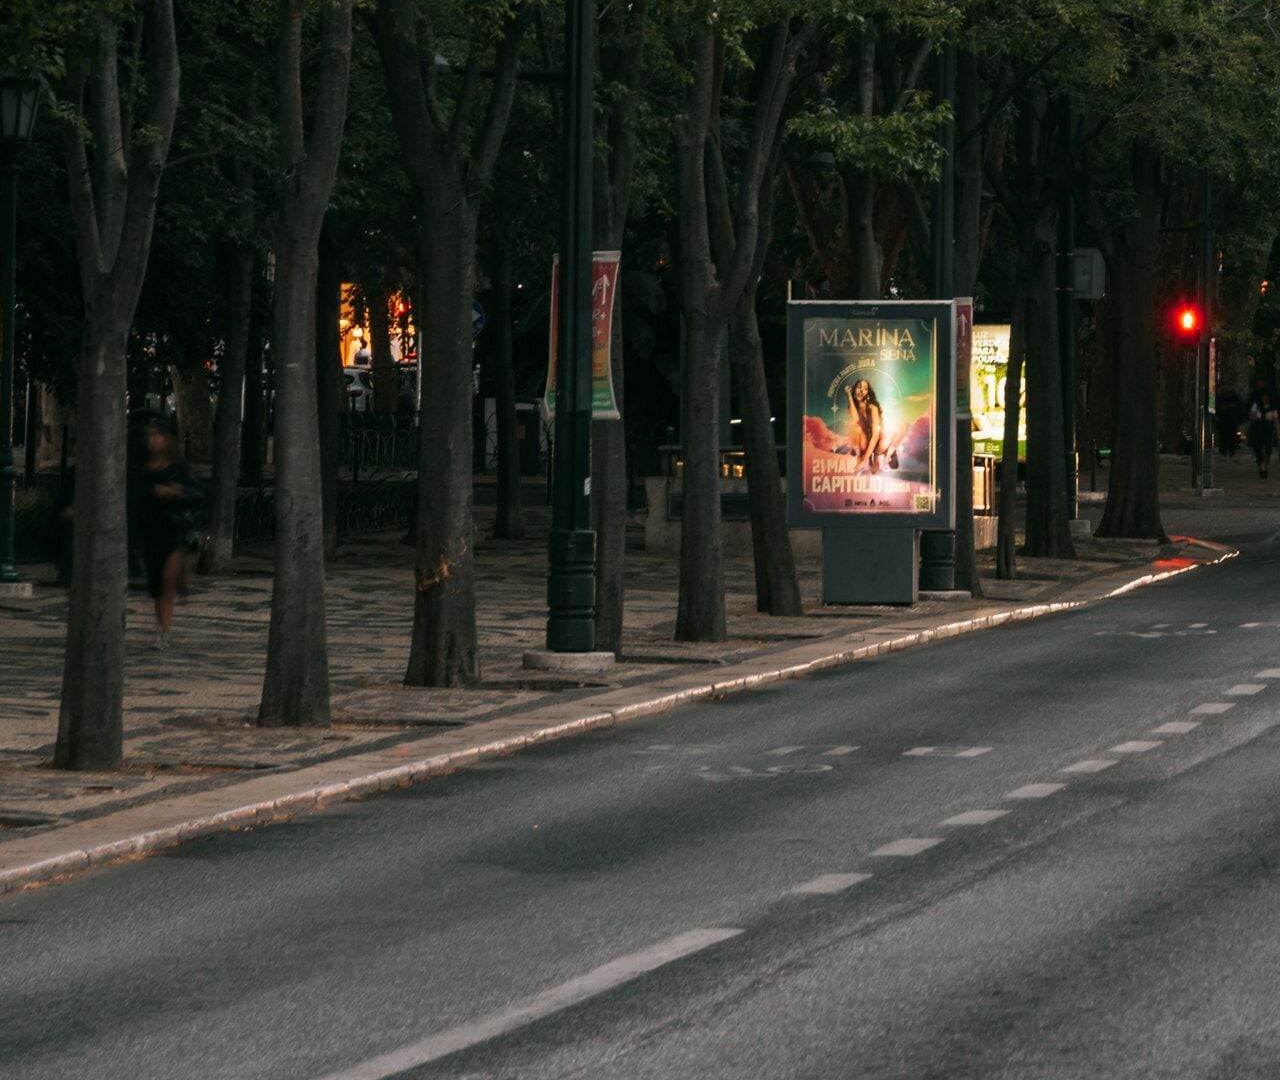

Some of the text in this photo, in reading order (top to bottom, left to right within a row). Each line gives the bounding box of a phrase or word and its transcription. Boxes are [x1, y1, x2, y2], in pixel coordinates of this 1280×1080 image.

[818, 322, 916, 348] MARINA
[880, 348, 916, 361] SENA
[812, 458, 825, 474] 21
